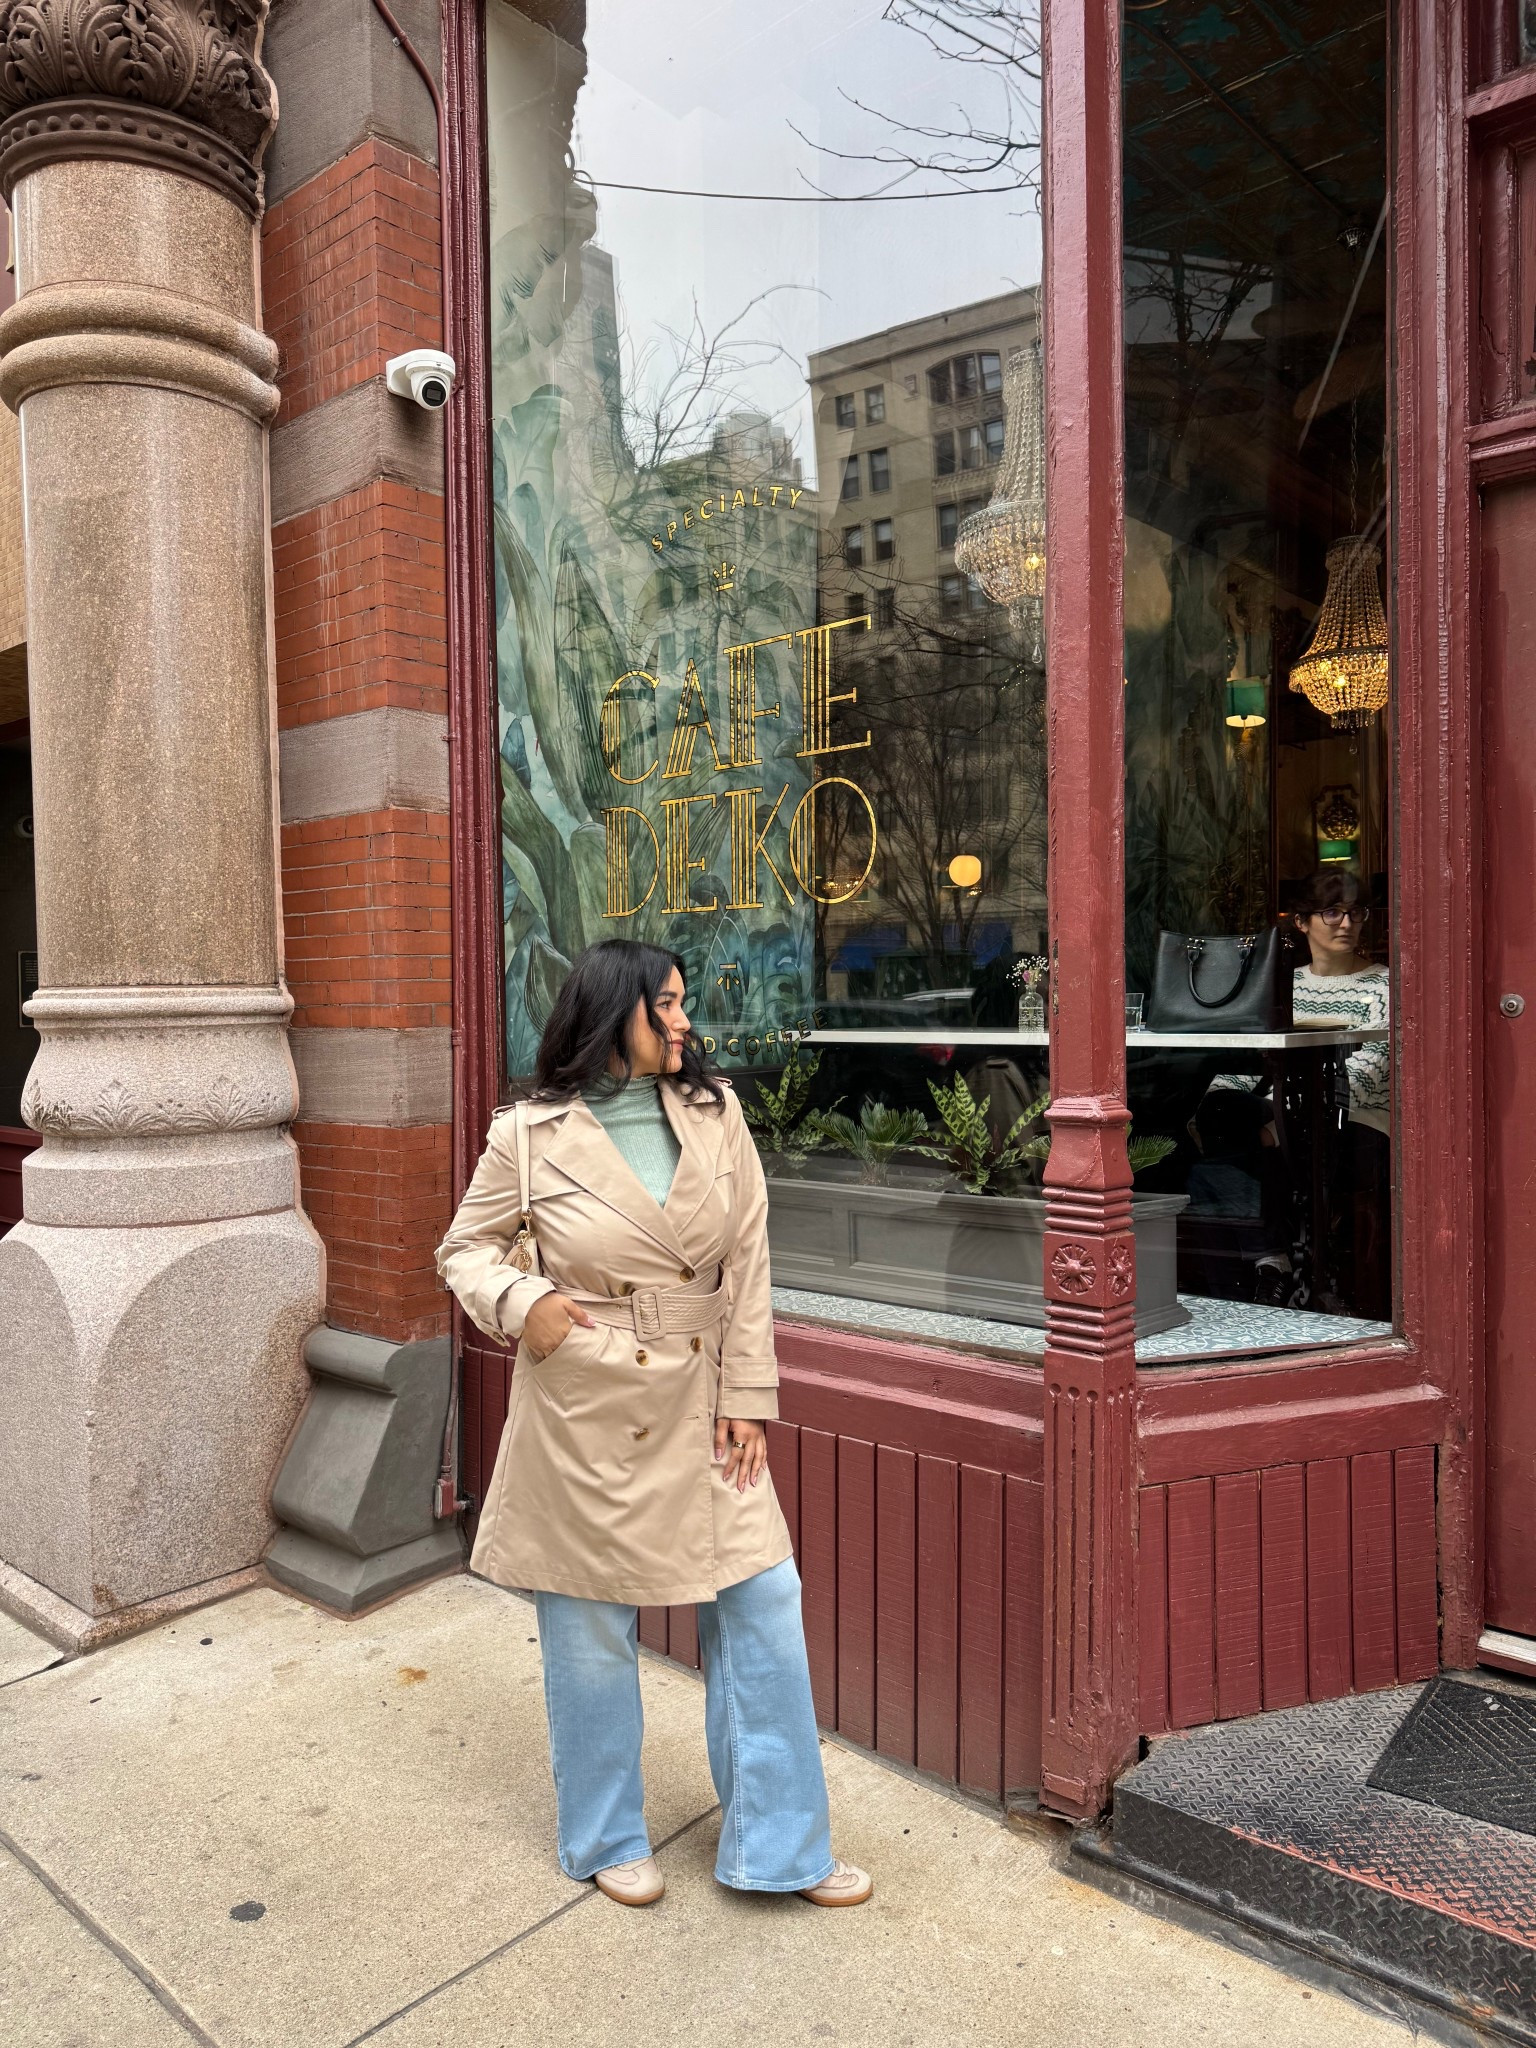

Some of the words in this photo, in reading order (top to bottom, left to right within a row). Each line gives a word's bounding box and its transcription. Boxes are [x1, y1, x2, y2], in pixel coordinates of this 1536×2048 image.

[651, 485, 803, 553] SPECIALTY
[600, 614, 871, 784] CAFE
[601, 777, 877, 918] DEKO
[726, 1008, 828, 1056] COFFEE
